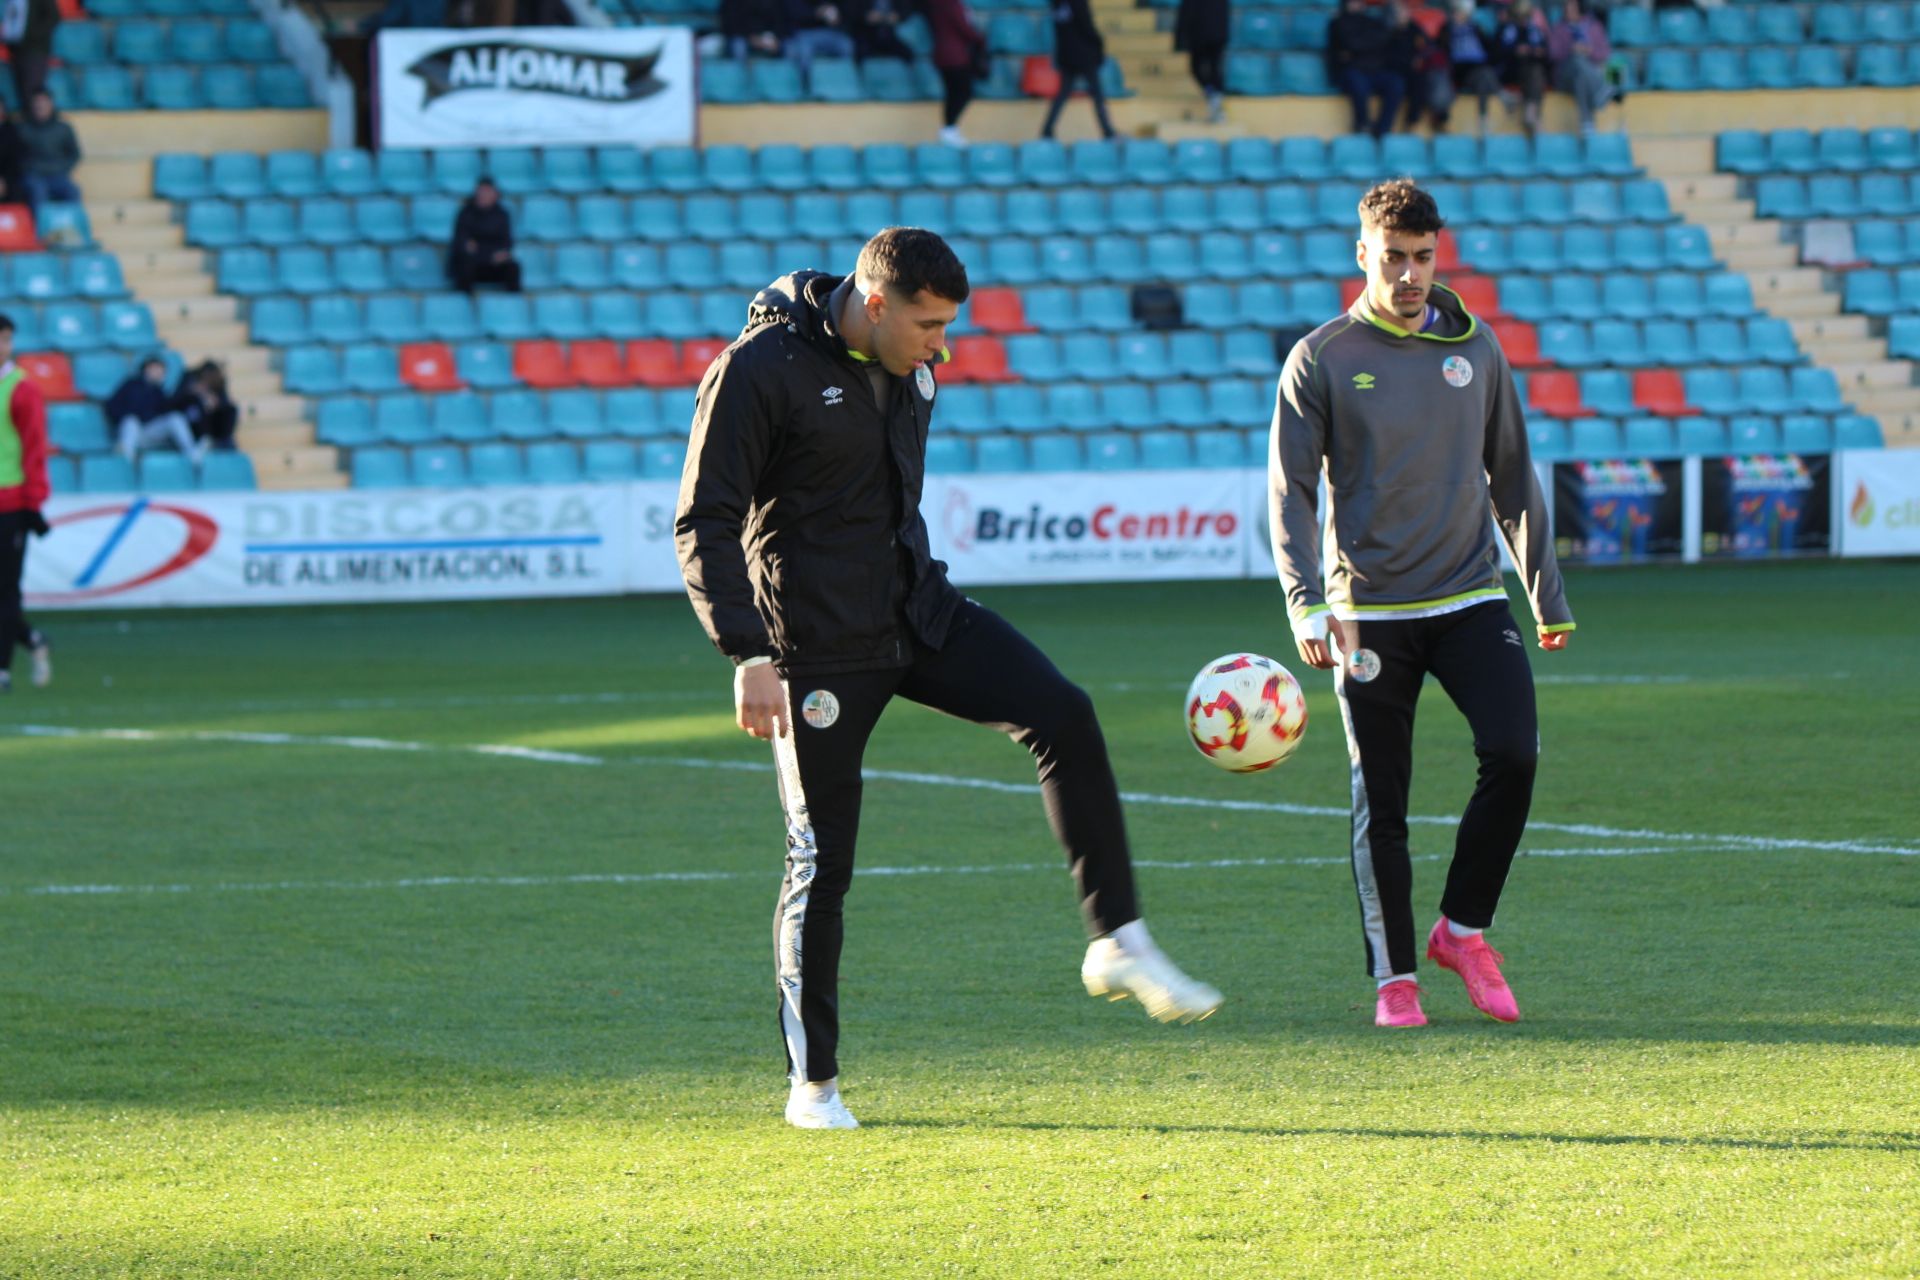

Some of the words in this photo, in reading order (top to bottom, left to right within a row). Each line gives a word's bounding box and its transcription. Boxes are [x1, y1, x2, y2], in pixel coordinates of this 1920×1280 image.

[451, 48, 628, 97] ALJOMAR
[246, 497, 599, 539] DISCOSA
[976, 505, 1236, 541] BricoCentro
[243, 556, 285, 587] DE
[295, 548, 537, 584] ALIMENTACIÓN,
